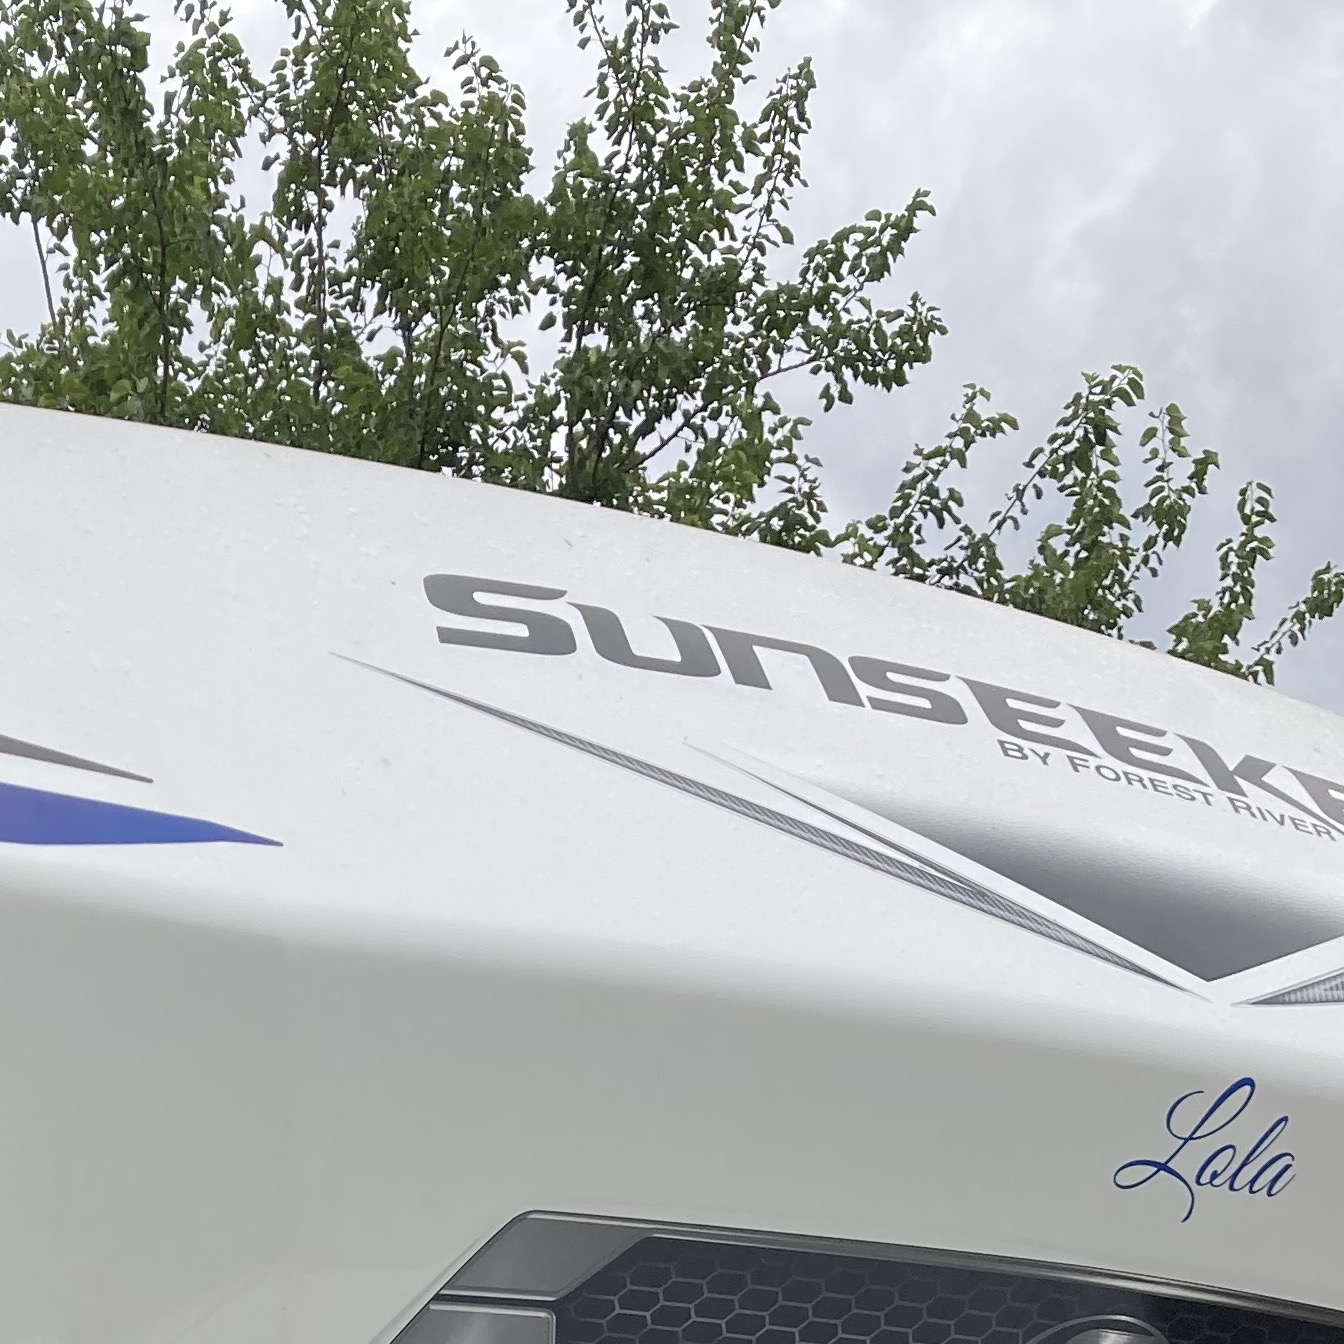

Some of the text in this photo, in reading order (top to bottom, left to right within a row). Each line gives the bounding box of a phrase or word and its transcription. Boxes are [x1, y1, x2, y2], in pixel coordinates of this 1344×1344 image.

[997, 739, 1337, 842] BY FOREST RIVER
[1114, 1076, 1298, 1223] Lola
